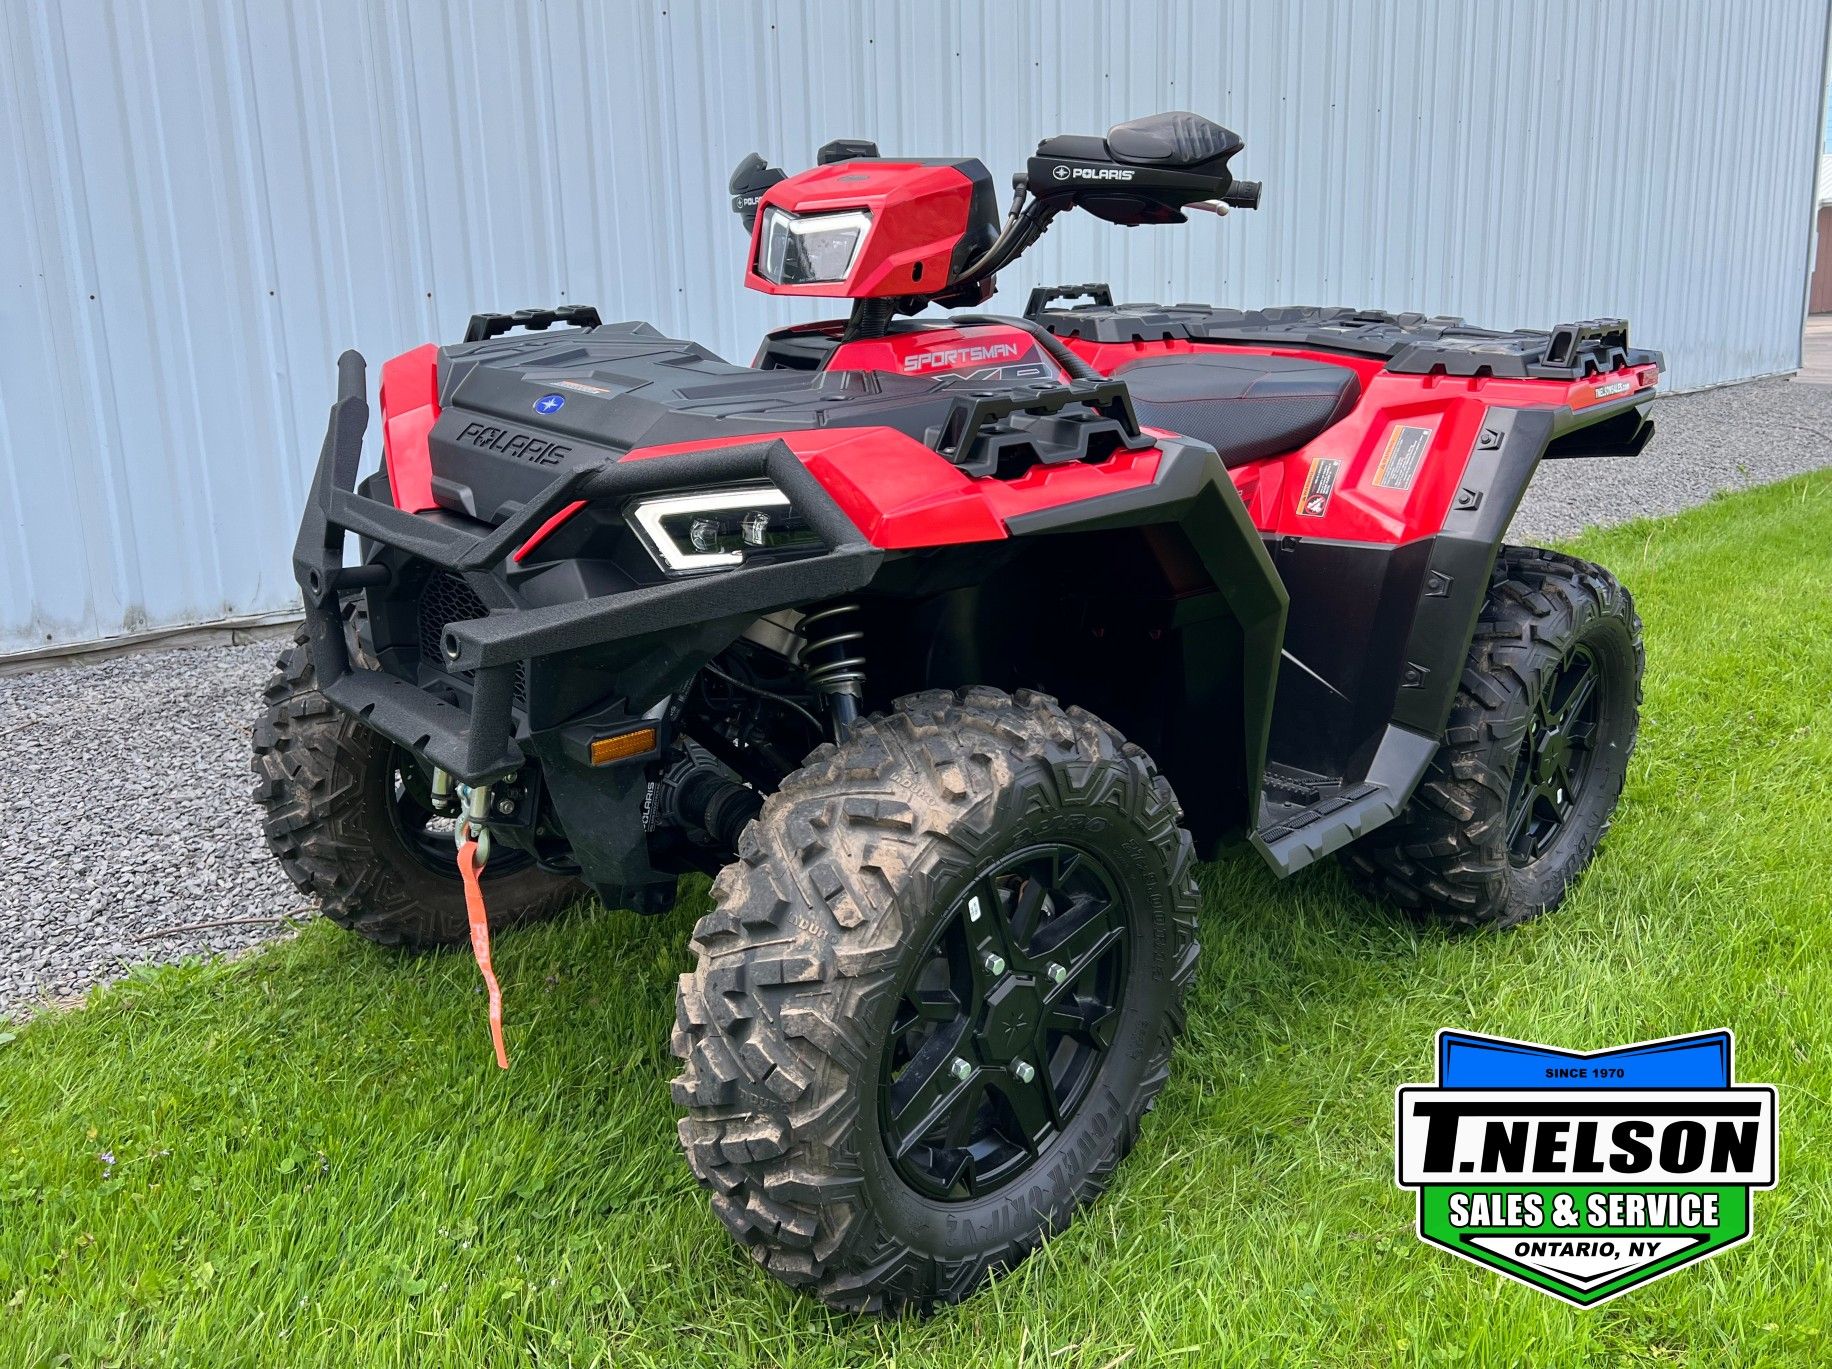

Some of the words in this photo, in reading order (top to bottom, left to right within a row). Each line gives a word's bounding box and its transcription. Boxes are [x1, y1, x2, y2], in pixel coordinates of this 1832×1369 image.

[1072, 168, 1133, 181] POLARIS
[903, 343, 1017, 371] SPORTSMAN
[456, 421, 573, 466] POLARIS
